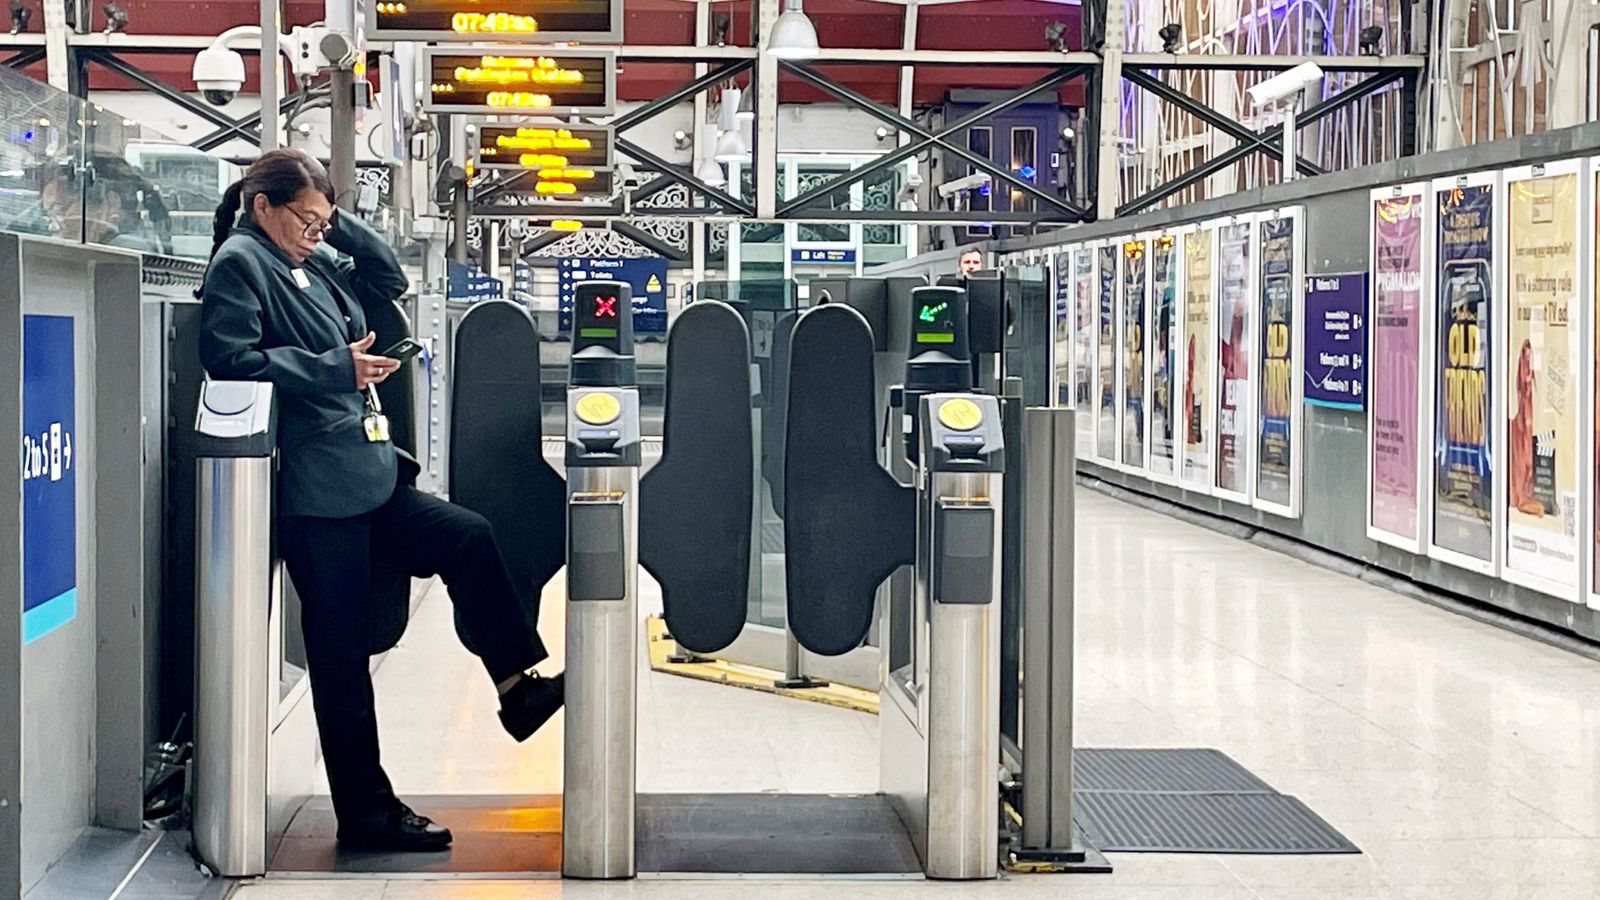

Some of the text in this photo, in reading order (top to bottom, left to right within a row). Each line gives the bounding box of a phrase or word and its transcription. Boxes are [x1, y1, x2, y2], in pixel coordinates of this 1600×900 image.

[1448, 322, 1481, 368] OLD
[24, 432, 49, 480] 2 to 5
